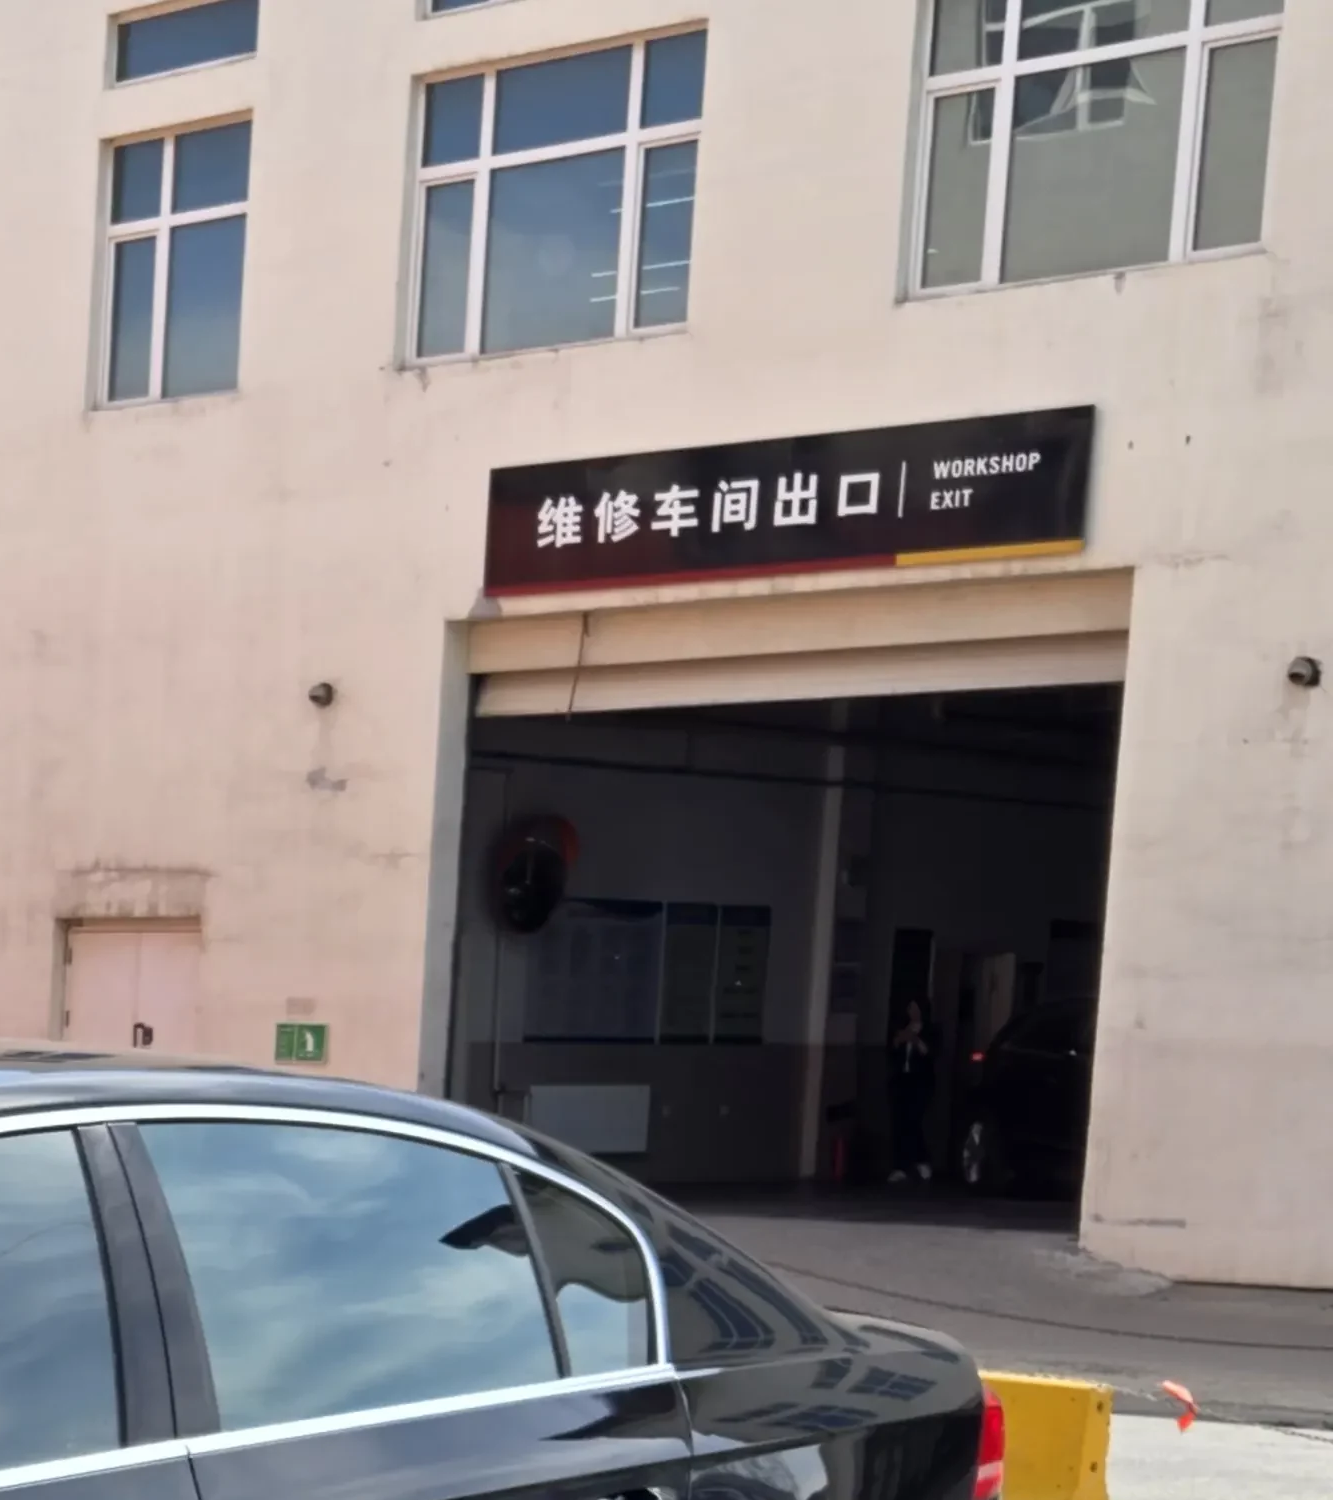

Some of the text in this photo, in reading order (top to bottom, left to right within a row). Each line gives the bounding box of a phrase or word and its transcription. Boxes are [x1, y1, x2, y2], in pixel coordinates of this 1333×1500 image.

[933, 452, 1041, 480] WORKSHOP
[536, 472, 880, 548] 维修车间出口
[930, 488, 974, 511] EXIT
